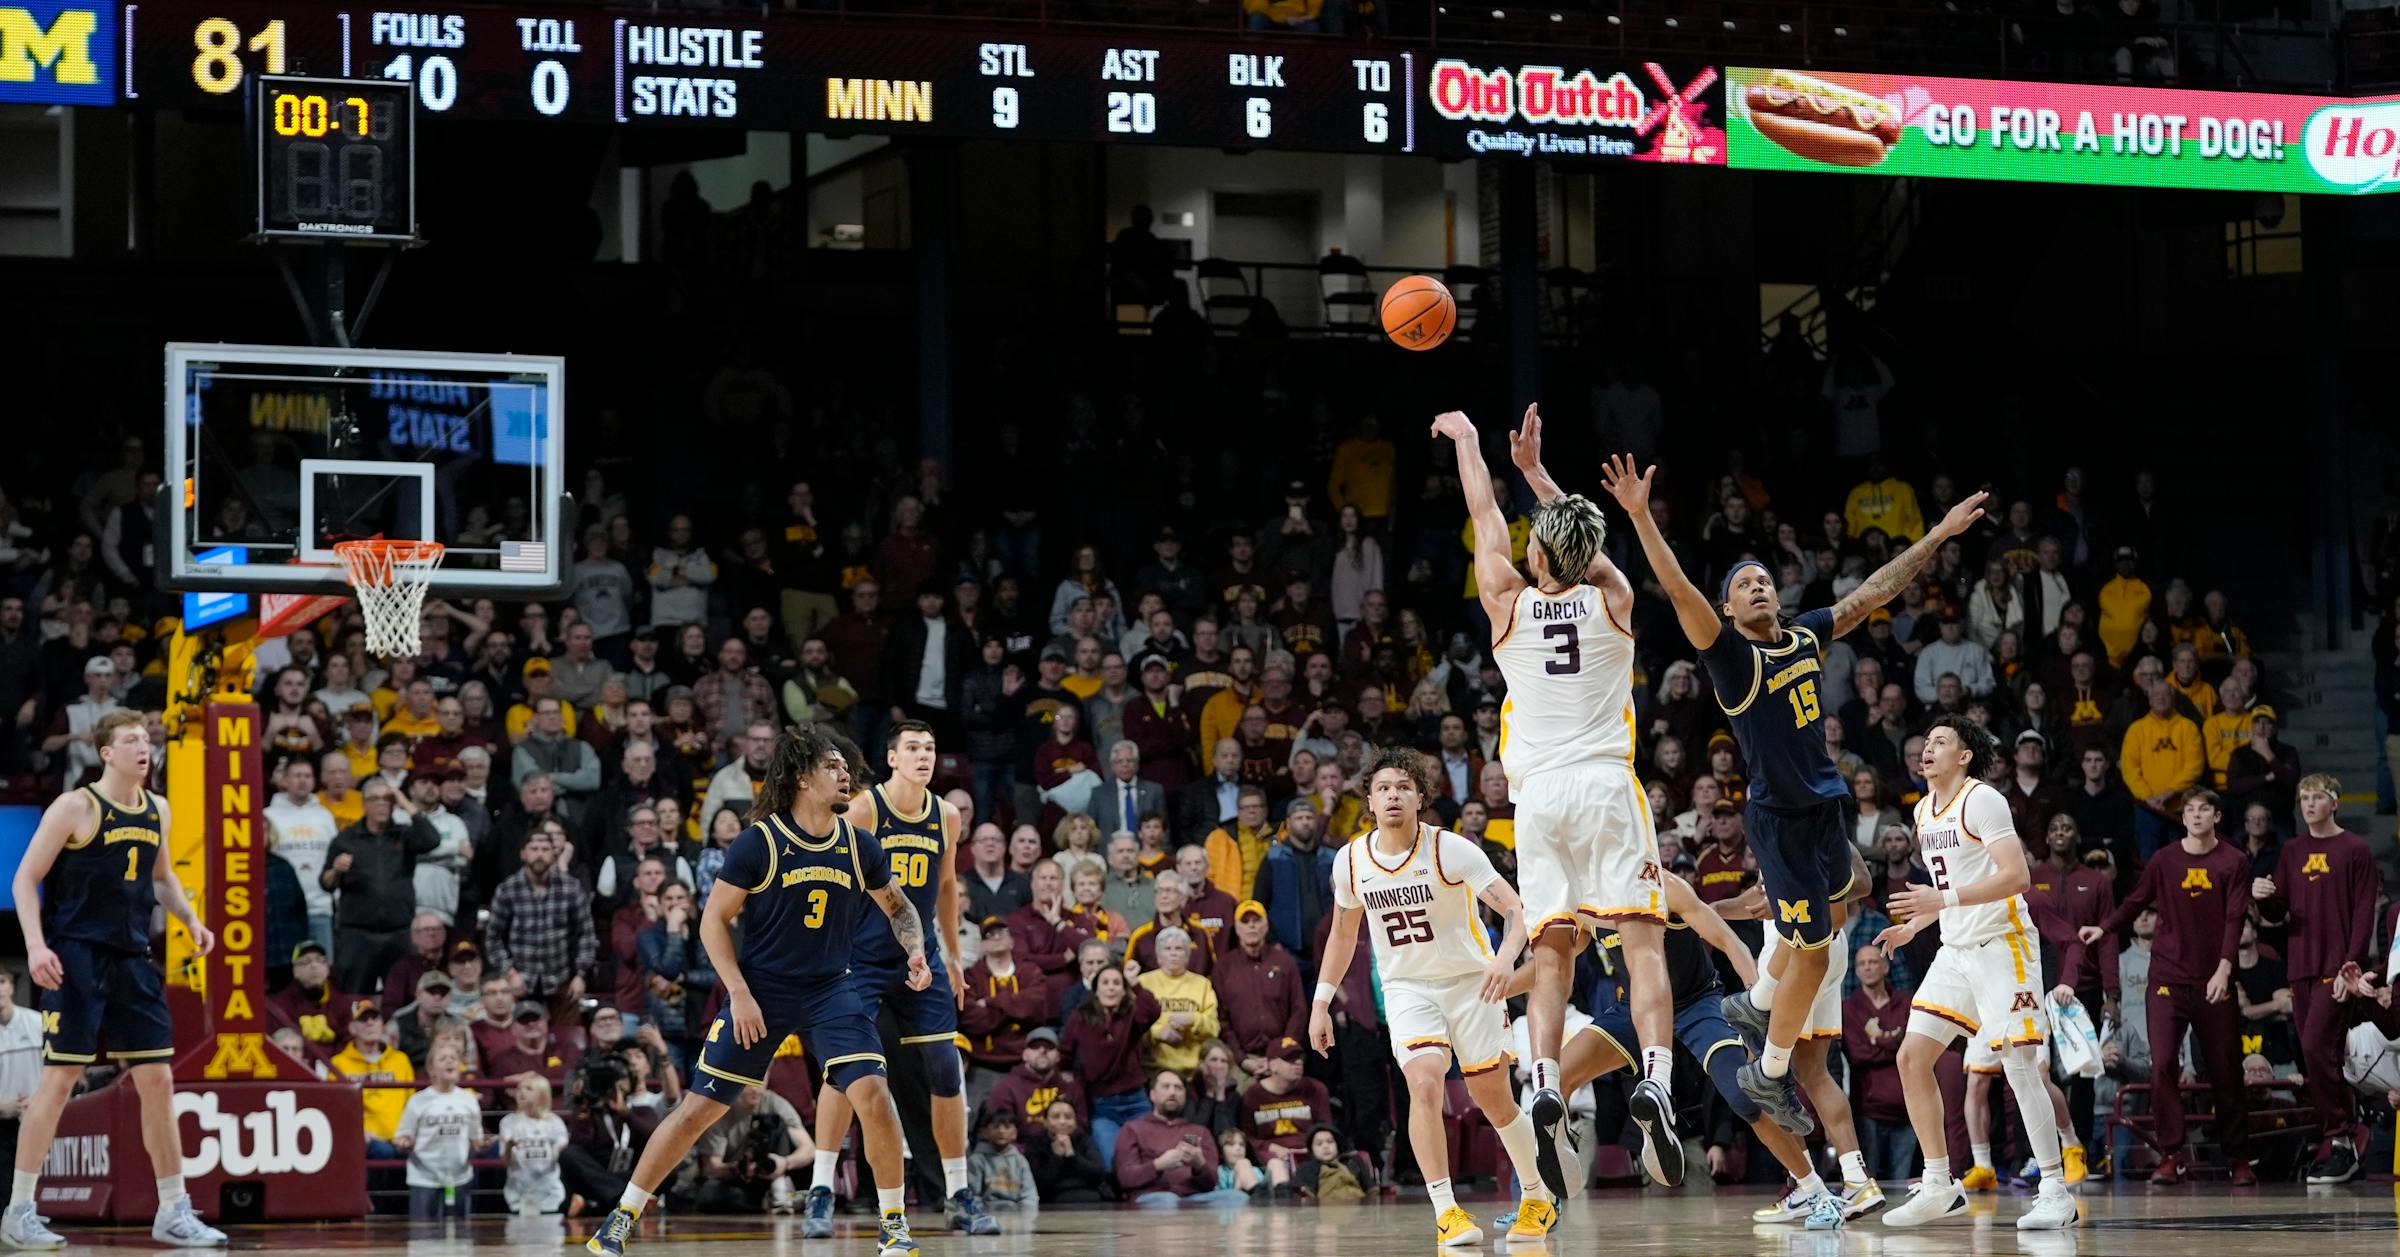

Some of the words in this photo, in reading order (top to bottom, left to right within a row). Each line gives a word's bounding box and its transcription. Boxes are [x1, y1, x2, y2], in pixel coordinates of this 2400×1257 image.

[0, 8, 99, 84] M
[372, 12, 466, 49] FOULS
[628, 29, 764, 69] HUSTLE
[192, 18, 287, 94] 81
[979, 43, 1035, 78] STL
[1102, 48, 1160, 83] AST
[1229, 53, 1287, 88] BLK
[1353, 59, 1391, 92] TO
[532, 60, 569, 117] 0
[633, 76, 738, 117] STATS
[826, 78, 933, 122] MINN
[992, 87, 1019, 129] 9
[1431, 60, 1515, 122] Old
[1517, 66, 1642, 127] Dutch
[275, 94, 369, 137] 00.7
[1108, 92, 1157, 134] 20
[1246, 97, 1271, 138] 6
[1363, 102, 1388, 143] 6
[1925, 104, 1976, 148] GO
[1992, 109, 2061, 151] FOR
[2074, 114, 2101, 154] A
[2119, 113, 2187, 158] HOT
[2200, 117, 2285, 162] DOG!
[1467, 130, 1537, 156] Quality
[1538, 133, 1587, 153] Lives
[2324, 116, 2400, 159] Ho
[298, 222, 374, 235] DAKTRONICS
[1533, 601, 1587, 620] GARCIA
[1543, 623, 1581, 675] 3
[1767, 657, 1820, 695] MICHIGAN
[1789, 679, 1820, 729] 15
[1919, 829, 1960, 851] MINNESOTA
[124, 846, 138, 881] 1
[217, 716, 253, 1020] MINNESOTA
[782, 866, 852, 890] MICHIGAN
[891, 853, 929, 888] 50
[1931, 856, 1949, 891] 2
[2181, 867, 2213, 889] M
[2302, 853, 2330, 873] M
[804, 889, 829, 929] 3
[1363, 884, 1435, 911] MINNESOTA
[1778, 898, 1812, 923] M
[1381, 908, 1436, 948] 25
[2010, 991, 2040, 1013] M
[203, 1032, 278, 1080] M
[2242, 1034, 2263, 1055] M
[172, 1090, 334, 1179] Cub
[82, 1134, 110, 1176] PLUS
